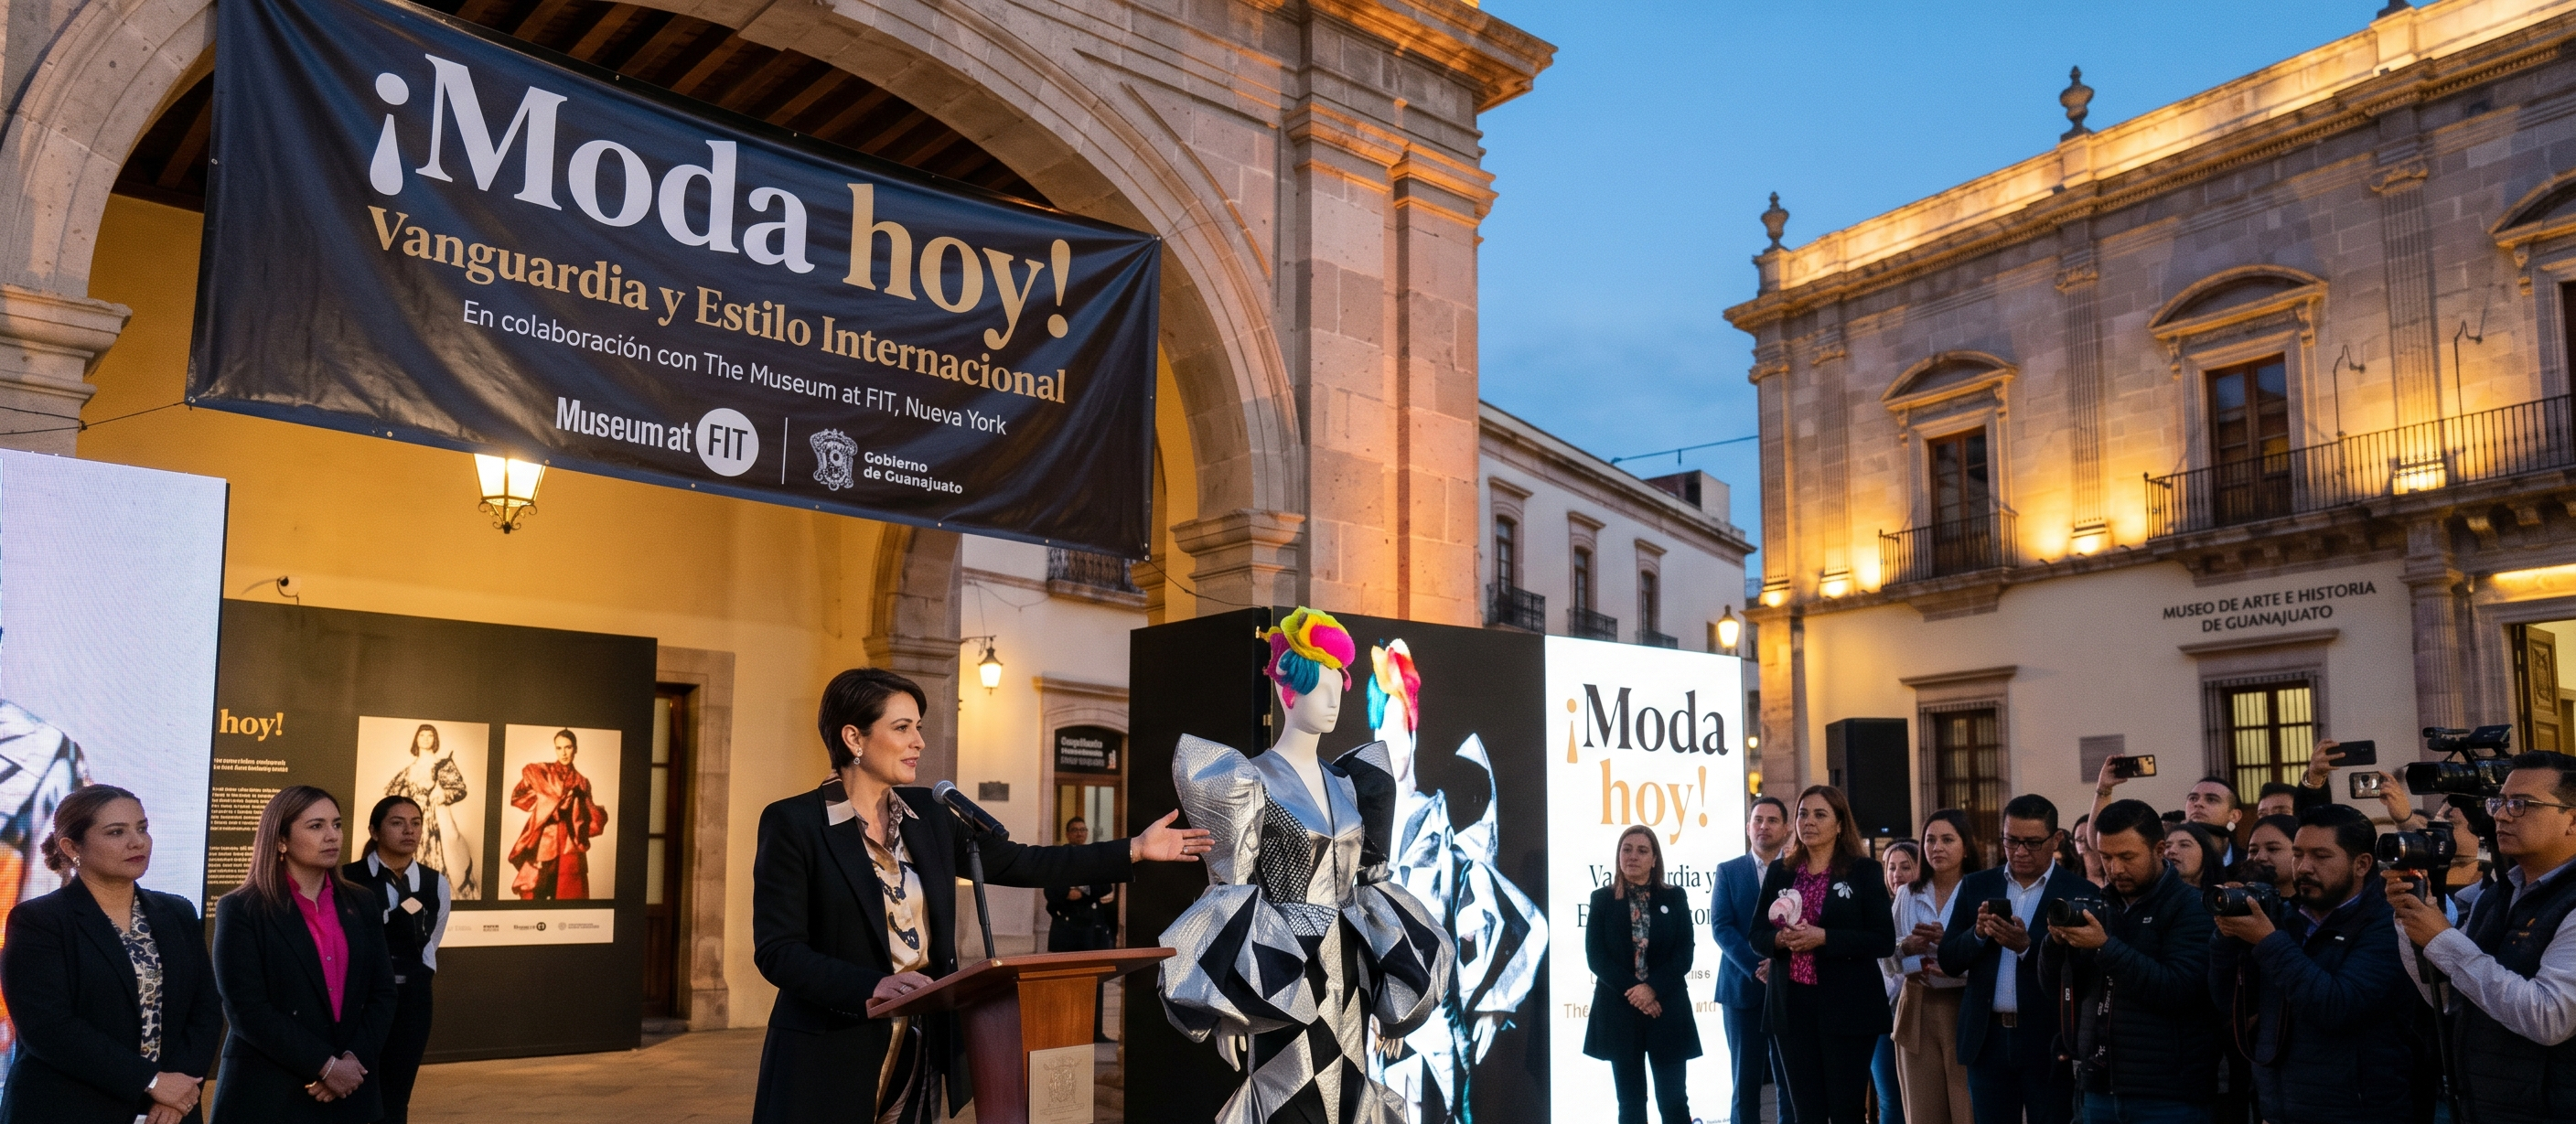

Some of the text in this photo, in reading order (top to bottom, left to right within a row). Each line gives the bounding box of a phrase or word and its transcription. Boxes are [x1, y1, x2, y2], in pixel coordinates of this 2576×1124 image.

[370, 53, 1071, 350] ¡Moda hoy!
[368, 205, 1066, 404] Vanguardia y Estilo Internacional
[463, 300, 1007, 435] En colaboración con The Museum at FIT, Nueva York
[555, 397, 749, 461] Museum at FIT
[863, 466, 963, 495] de Guanajuato
[864, 451, 928, 474] Gobierno
[2163, 581, 2377, 620] MUSEO DE ARTE E HISTORIA
[2202, 605, 2334, 633] DE GUANAJUATO
[219, 709, 284, 742] hoy!
[1566, 683, 1729, 764] ¡Moda
[1599, 758, 1708, 845] hoy!
[1589, 864, 1717, 894] Vardia y
